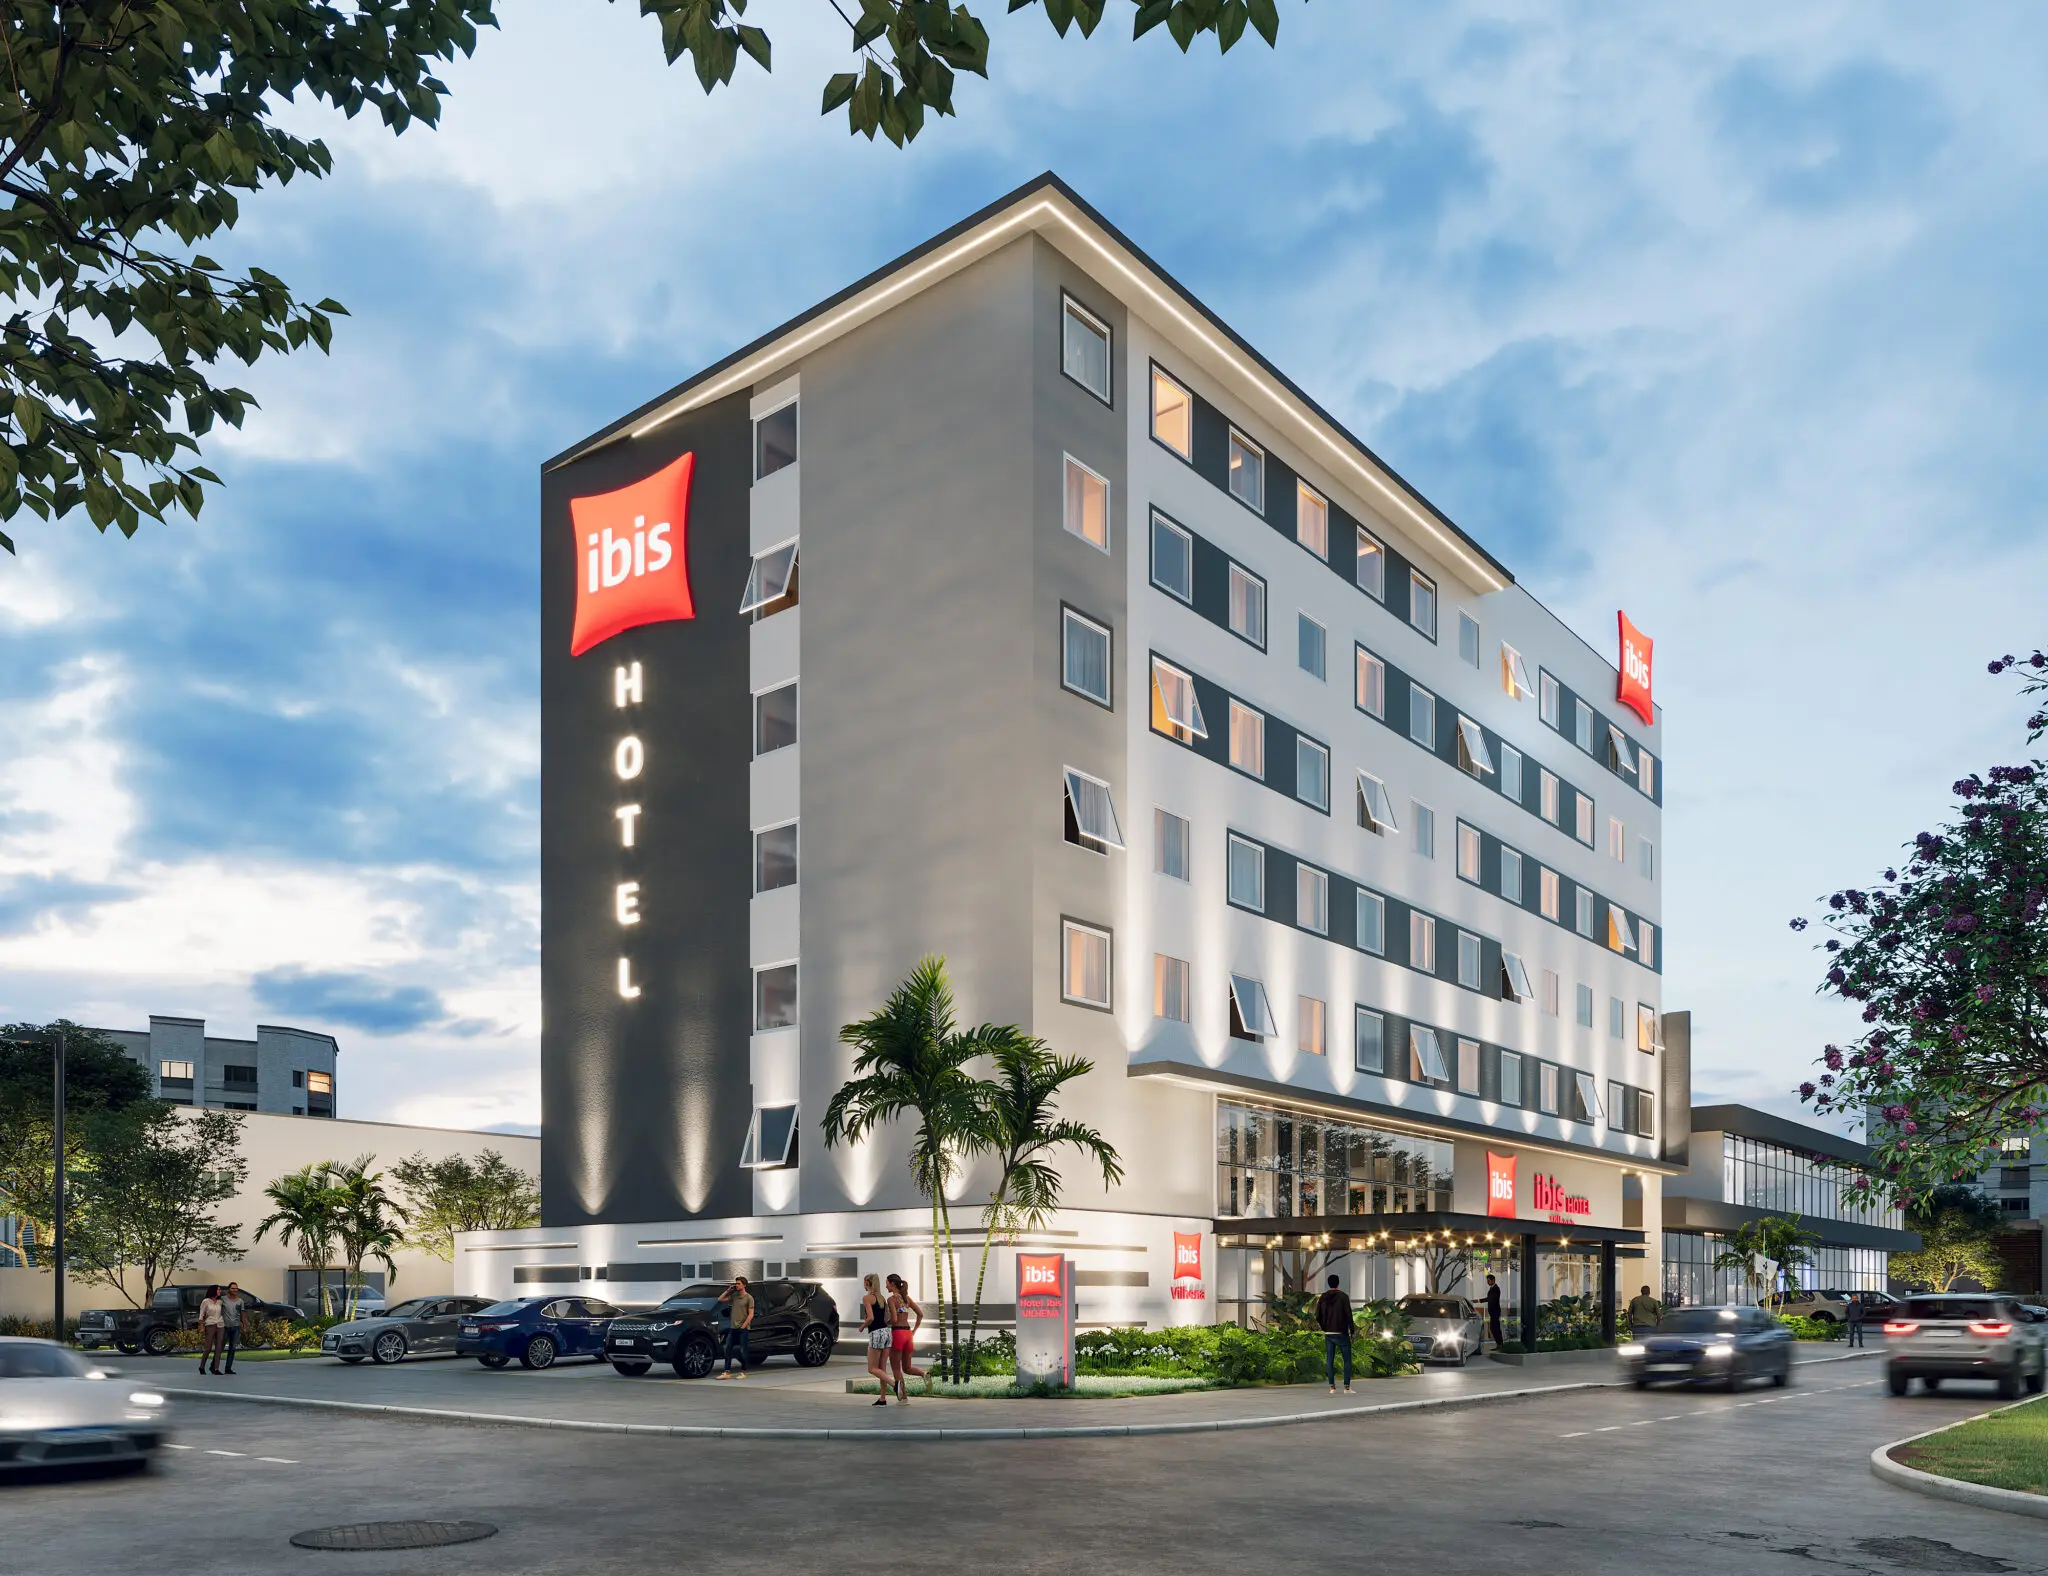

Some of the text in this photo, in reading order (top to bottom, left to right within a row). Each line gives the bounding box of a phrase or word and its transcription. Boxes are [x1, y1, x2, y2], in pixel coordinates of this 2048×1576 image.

[588, 515, 672, 593] ibis
[1625, 640, 1649, 689] ibis
[615, 661, 644, 999] HOTEL
[1492, 1170, 1512, 1199] ibis
[1534, 1173, 1591, 1214] ibis HOTEL
[1178, 1244, 1198, 1265] ibis
[1025, 1265, 1056, 1283] ibis
[1170, 1285, 1206, 1300] Vilhena
[1022, 1308, 1061, 1319] VILHENA
